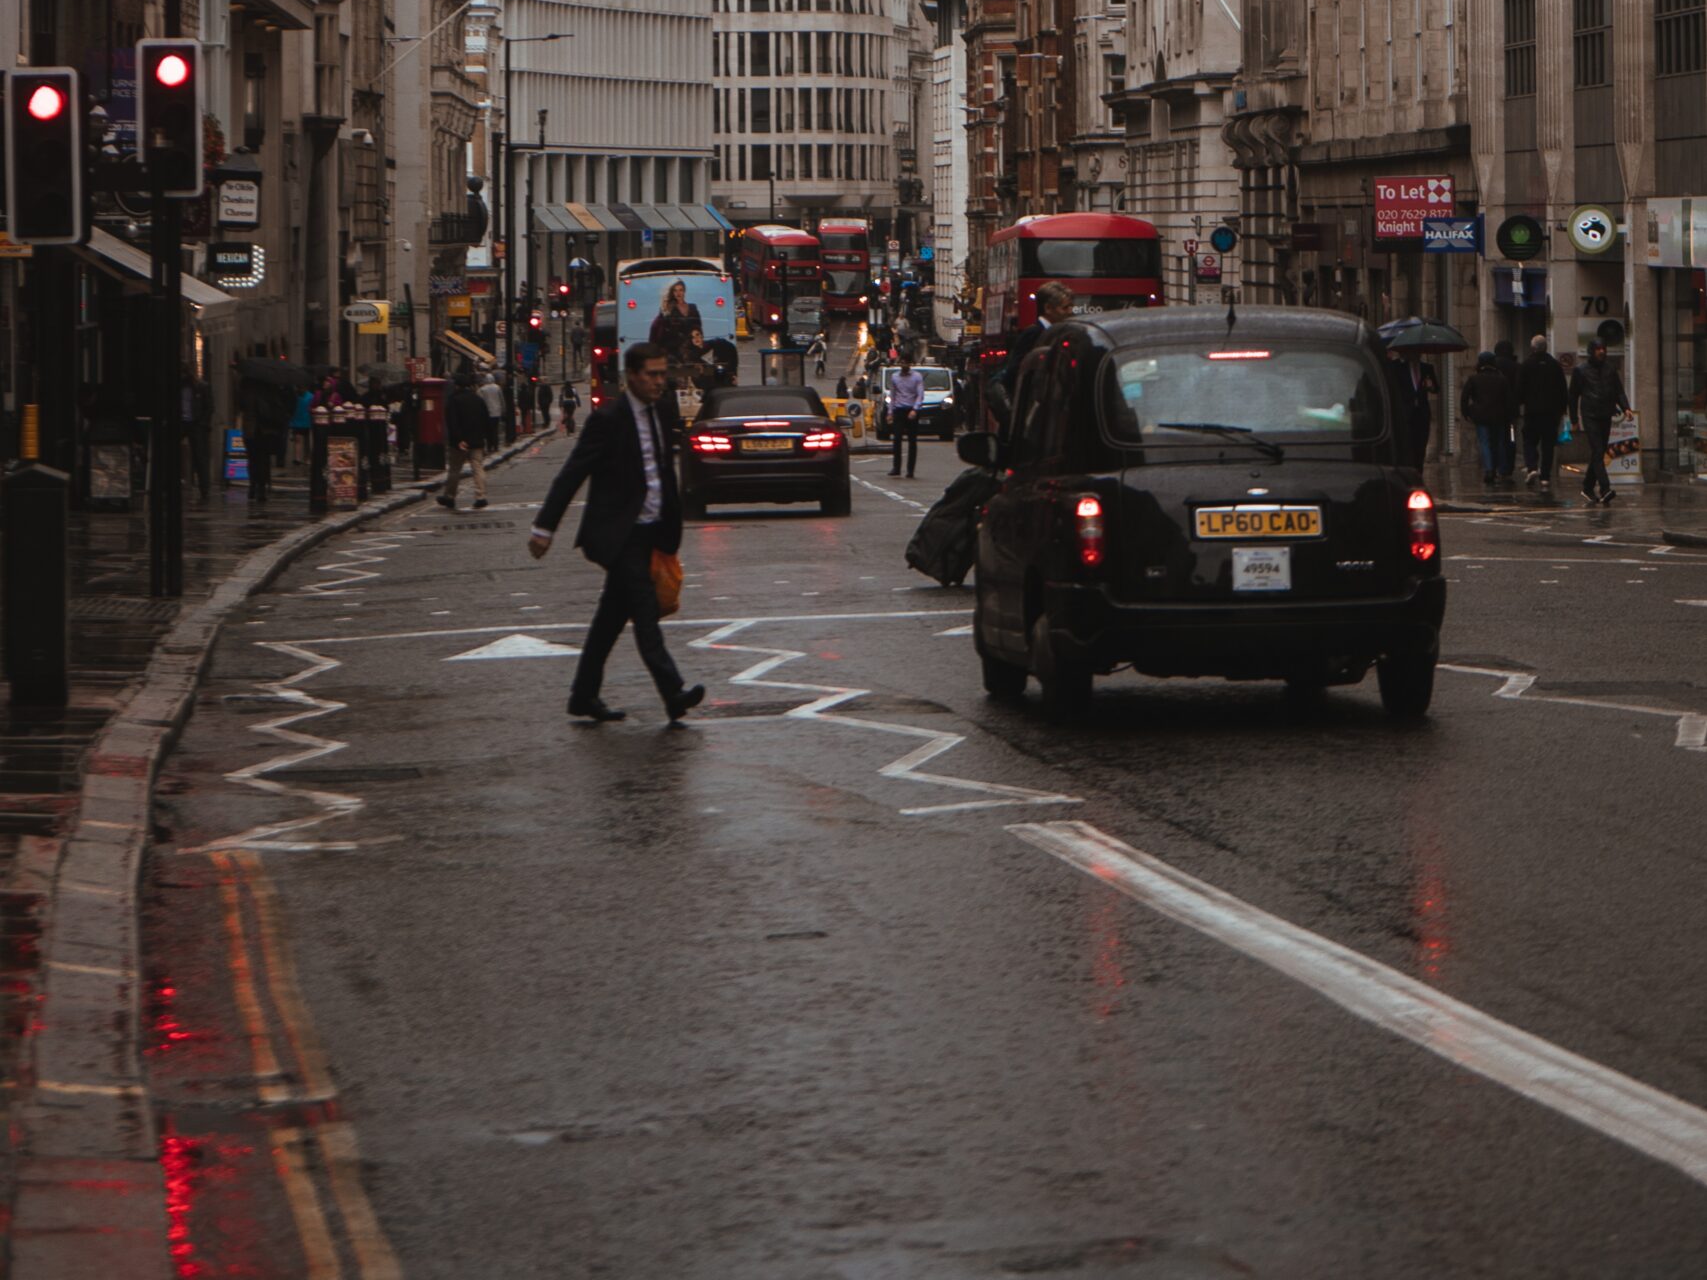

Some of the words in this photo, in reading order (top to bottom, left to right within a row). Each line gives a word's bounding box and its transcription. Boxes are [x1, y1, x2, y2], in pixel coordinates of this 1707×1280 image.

[1376, 185, 1396, 200] To
[1400, 184, 1425, 200] Let
[1377, 209, 1398, 220] 020
[1401, 209, 1427, 220] 7629
[1429, 209, 1453, 218] 8171
[1377, 220, 1415, 235] Knight
[1425, 230, 1474, 239] HALIFAX
[215, 252, 249, 263] MEXICAN
[1071, 303, 1103, 314] erloo
[1580, 295, 1609, 316] 70
[1207, 513, 1263, 533] LP60
[1269, 512, 1310, 532] CAO
[1243, 563, 1280, 574] 49594
